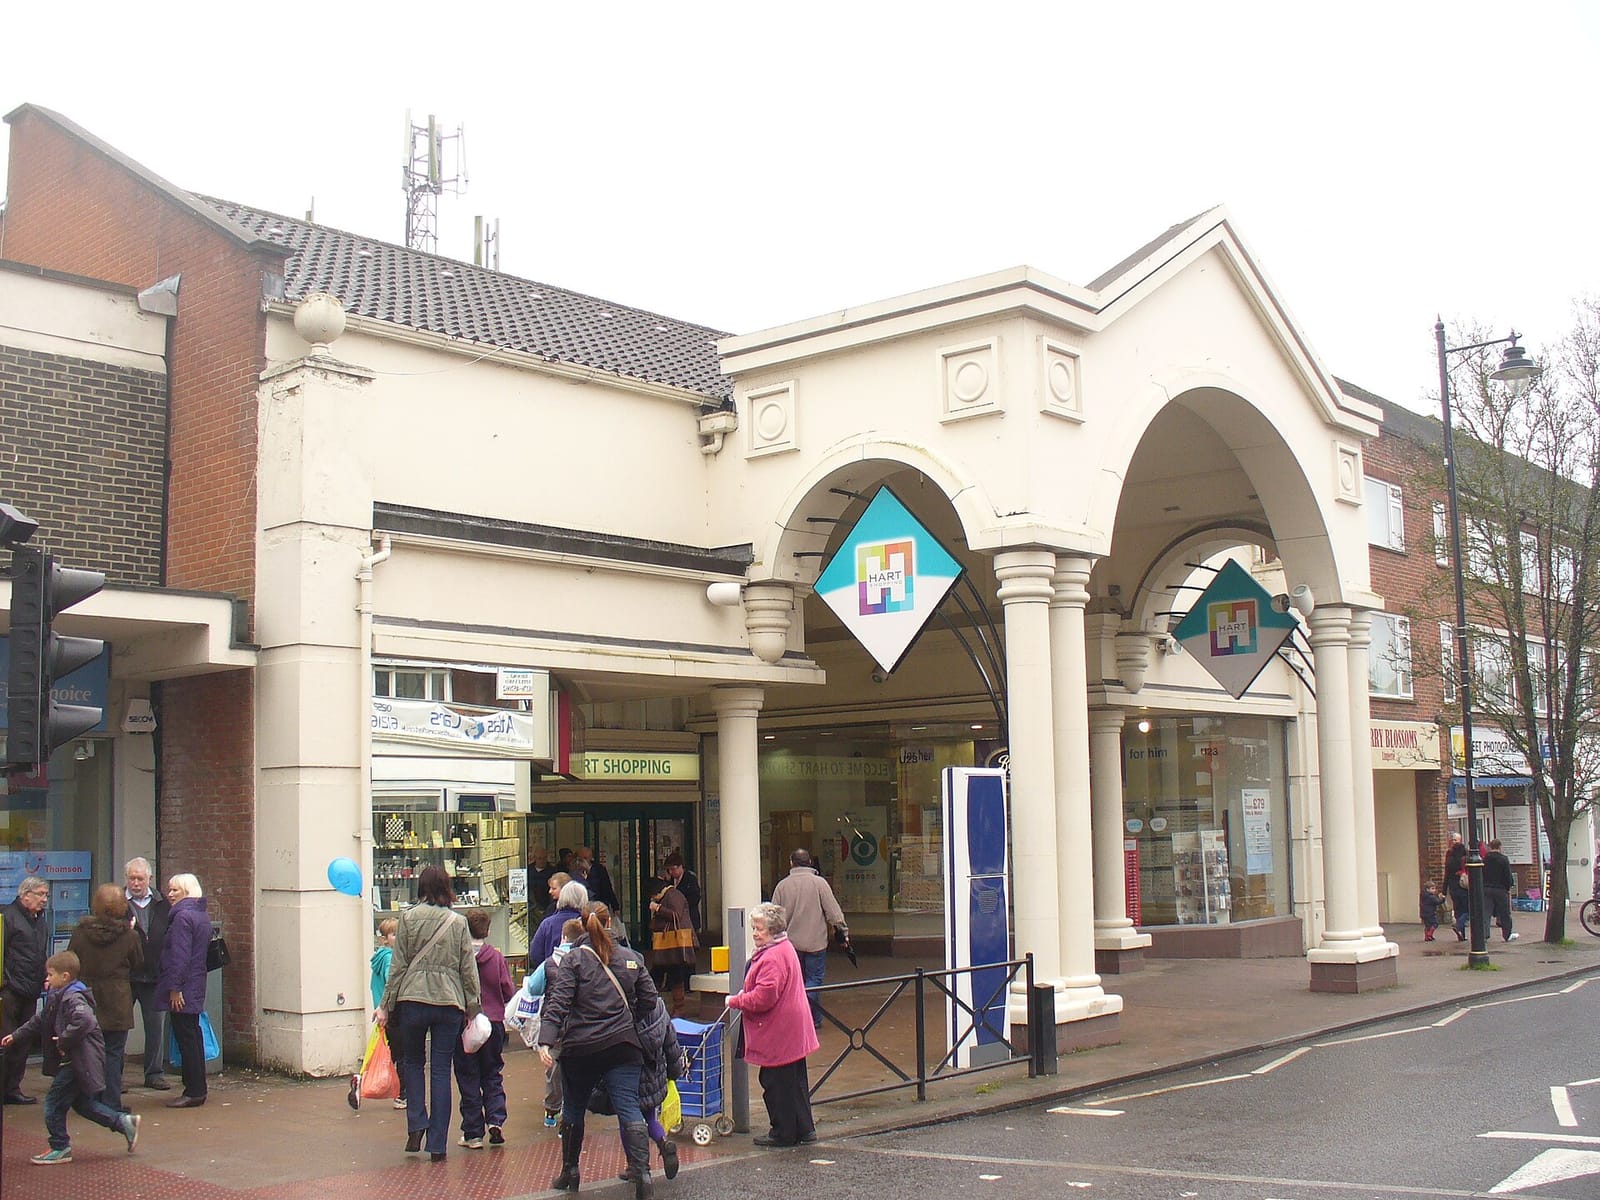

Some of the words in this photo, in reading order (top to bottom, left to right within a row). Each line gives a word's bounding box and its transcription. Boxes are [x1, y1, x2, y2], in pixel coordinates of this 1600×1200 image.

[869, 570, 902, 583] HART
[1219, 622, 1246, 631] HART
[128, 715, 154, 723] SECOM
[1385, 729, 1418, 749] BLOSSOMS
[1129, 749, 1145, 760] for
[1148, 747, 1168, 758] him
[603, 758, 671, 774] SHOPPING
[44, 864, 83, 873] Thomson
